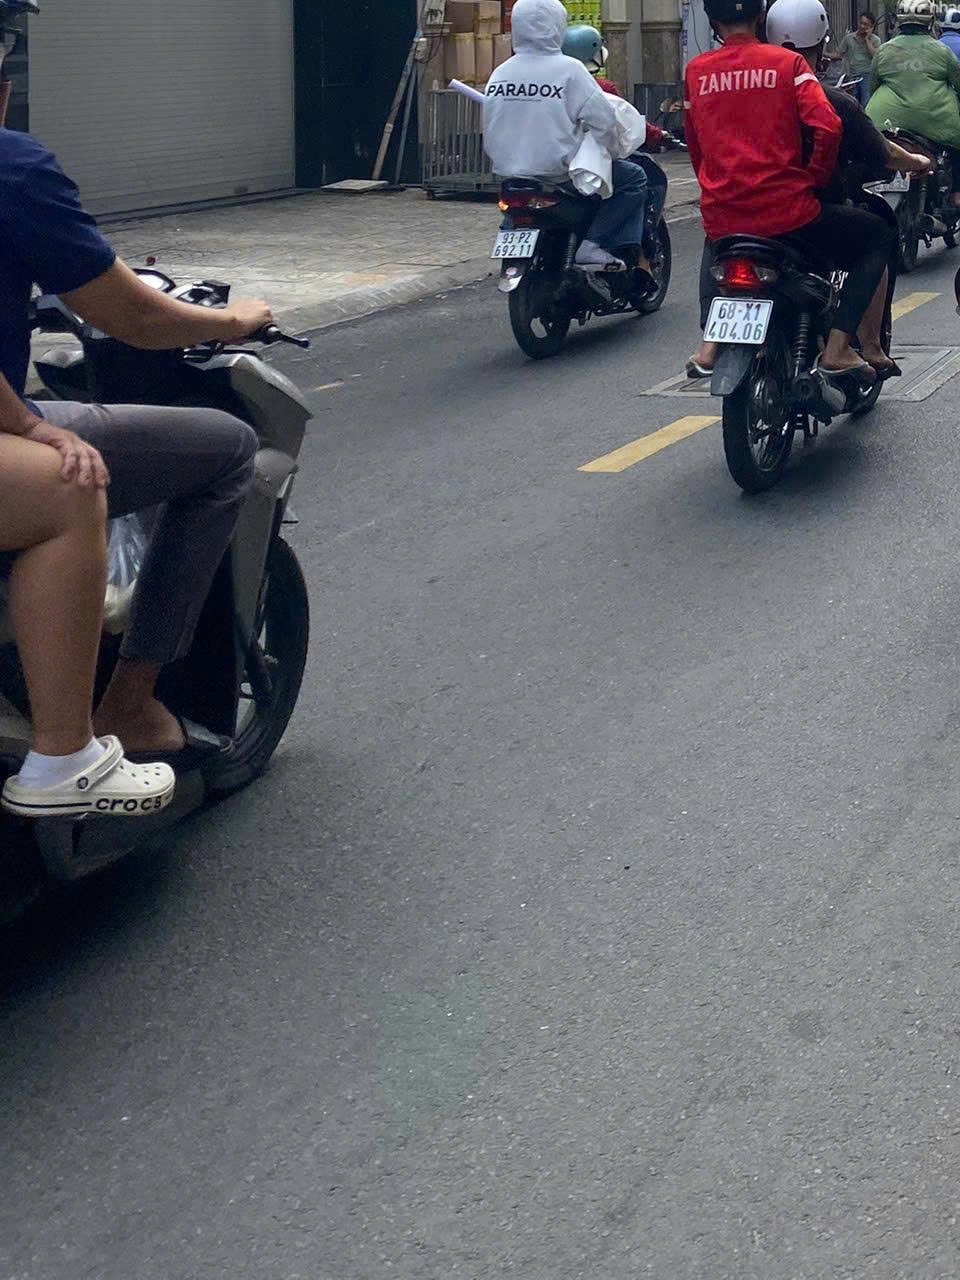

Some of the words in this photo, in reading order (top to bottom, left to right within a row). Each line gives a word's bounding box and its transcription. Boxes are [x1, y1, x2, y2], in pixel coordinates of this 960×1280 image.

[486, 83, 564, 99] PARADOX
[698, 68, 778, 96] ZANTINO
[495, 245, 531, 257] 692.11
[718, 302, 762, 322] 68-X1
[708, 321, 763, 341] 404.06
[96, 796, 162, 811] crocs
